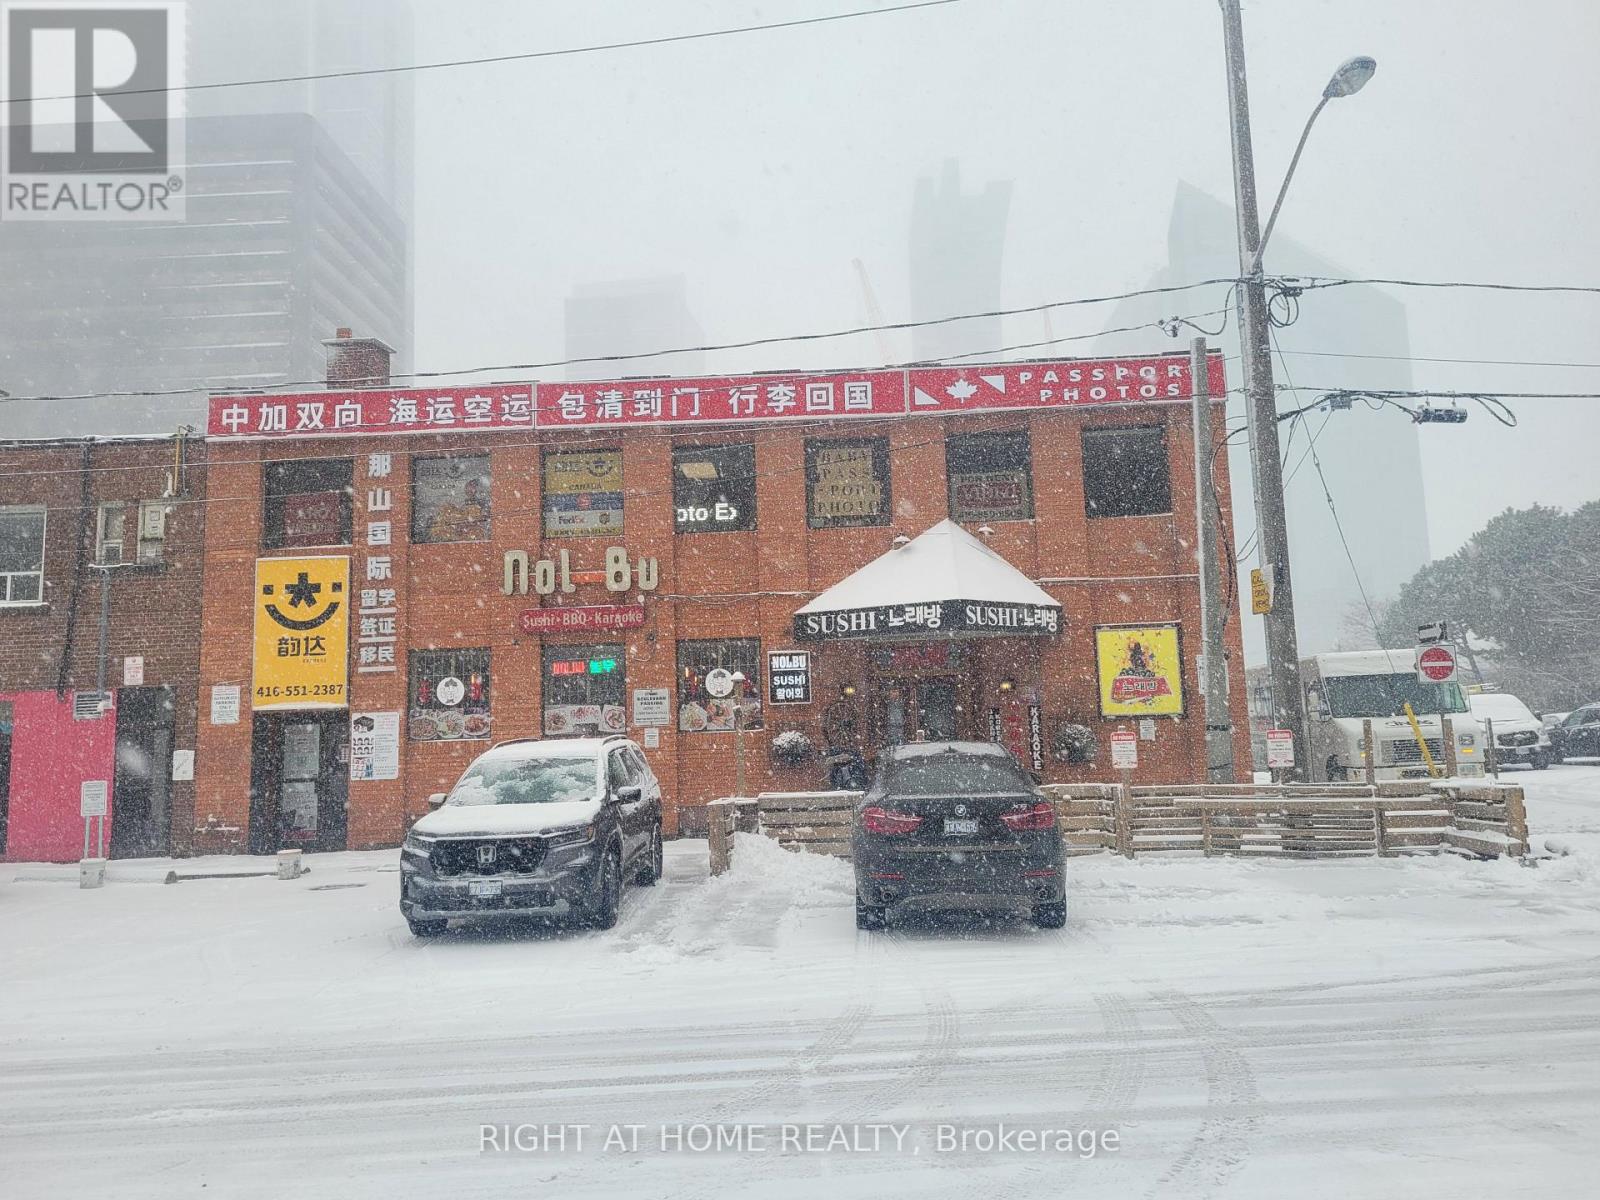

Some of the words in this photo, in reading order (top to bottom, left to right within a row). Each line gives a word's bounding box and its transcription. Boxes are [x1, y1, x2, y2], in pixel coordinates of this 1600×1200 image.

[1019, 365, 1190, 384] PASSPOR
[557, 387, 700, 420] 包清到门
[728, 381, 873, 414] 行李回国
[1040, 383, 1180, 401] PHOTOS
[221, 400, 362, 432] 中加双向
[388, 393, 531, 425] 海运空运
[524, 614, 556, 627] Sushi
[562, 612, 587, 625] BBQ
[595, 611, 643, 624] Karaoke
[807, 611, 877, 634] SUSHI
[888, 605, 942, 628] 노래방
[966, 605, 1018, 627] SUSHI
[1023, 608, 1057, 632] 노래방
[278, 635, 326, 657] 韵达
[771, 655, 807, 669] NOLBU
[773, 674, 806, 686] SUSHI
[257, 683, 343, 698] 416-551-2387
[1030, 706, 1042, 769] KARAOKE
